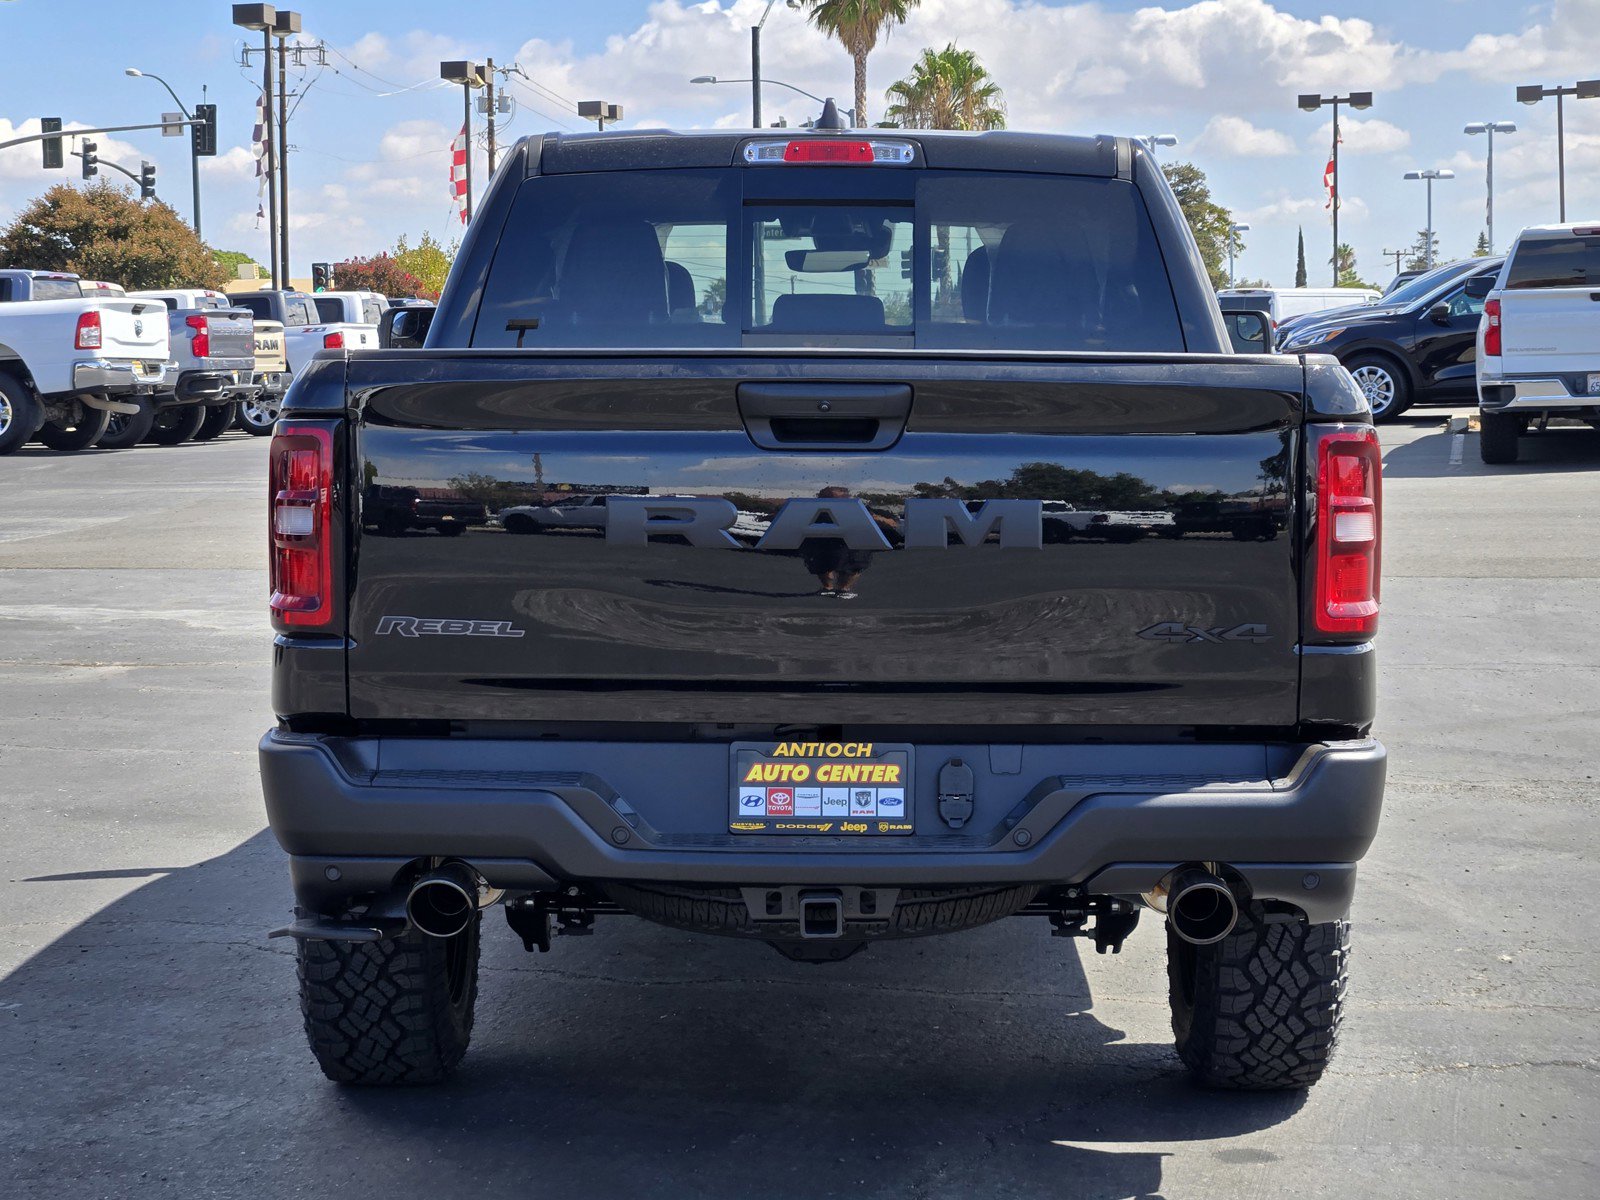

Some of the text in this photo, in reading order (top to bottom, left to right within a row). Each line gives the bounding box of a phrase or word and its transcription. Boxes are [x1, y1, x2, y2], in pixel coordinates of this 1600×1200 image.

[254, 340, 279, 350] RAM
[605, 499, 1043, 550] RAM
[375, 616, 526, 637] REBEL
[773, 743, 873, 757] ANTIOCH
[745, 764, 901, 783] AUTO CENTER
[824, 797, 847, 807] Jeep
[840, 822, 868, 832] Jeep
